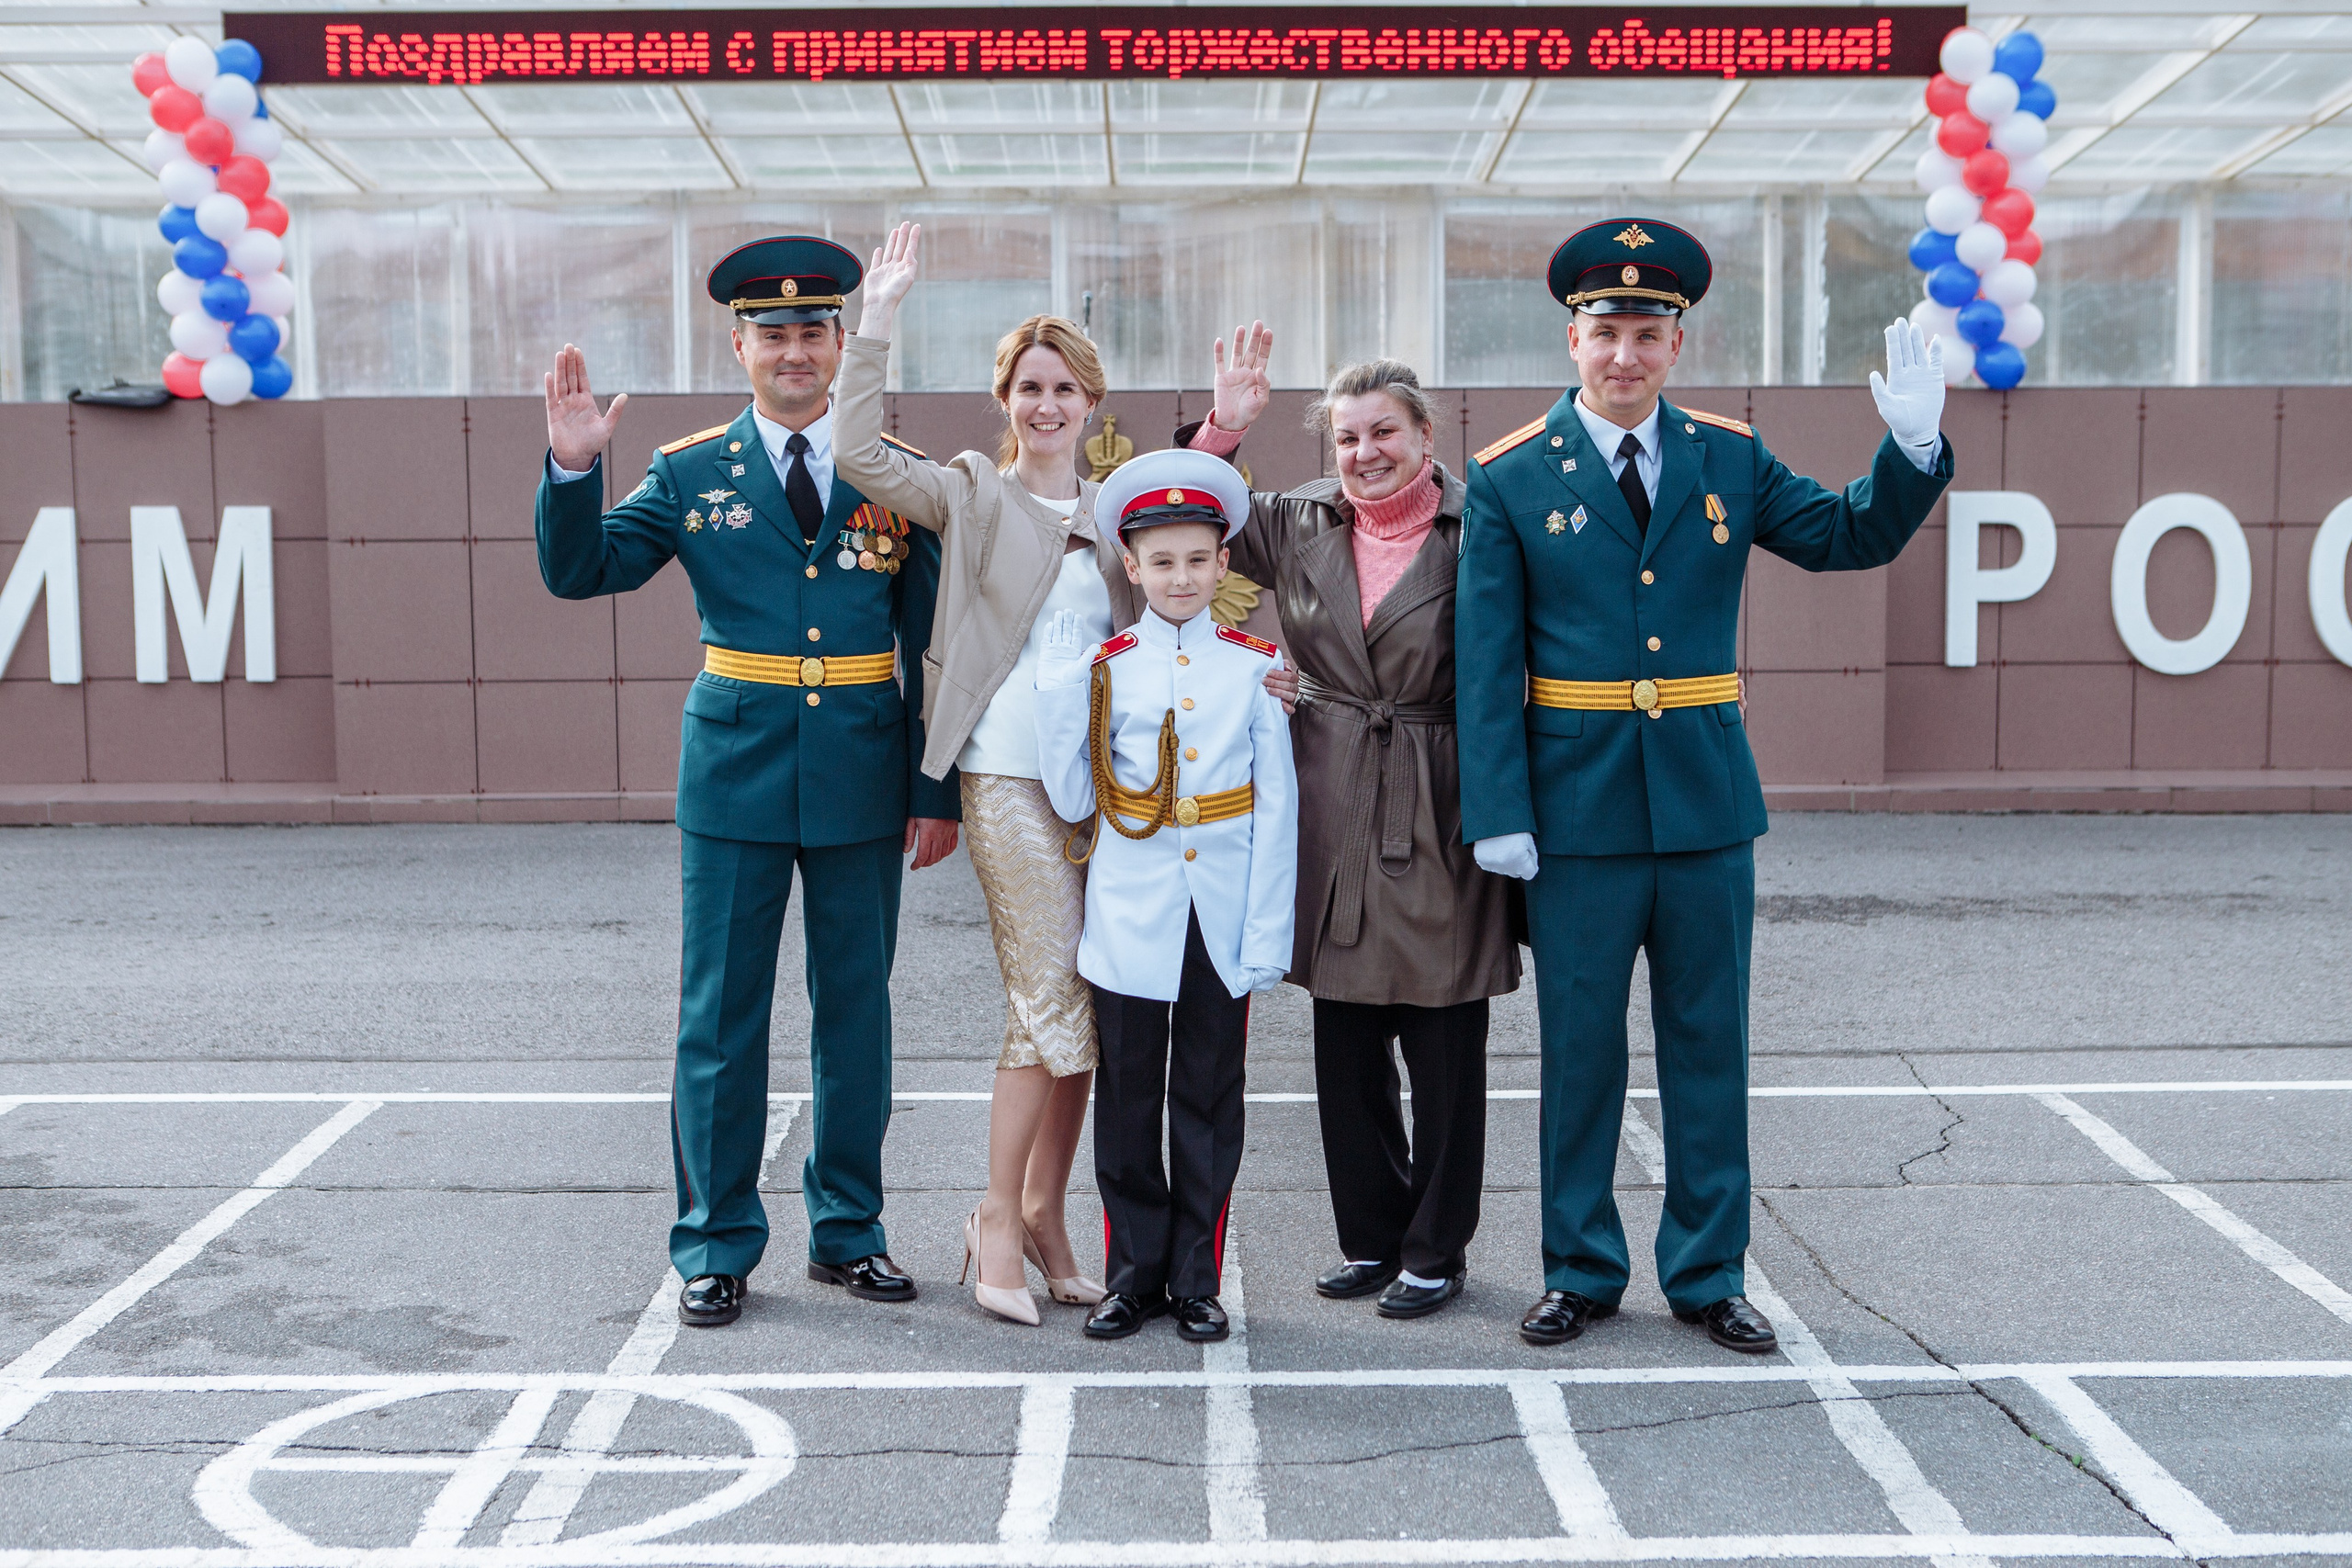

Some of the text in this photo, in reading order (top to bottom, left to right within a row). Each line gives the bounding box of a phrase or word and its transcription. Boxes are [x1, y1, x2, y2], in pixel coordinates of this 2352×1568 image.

[324, 17, 1893, 85] Поздравляем с принятием торжественного обещания!
